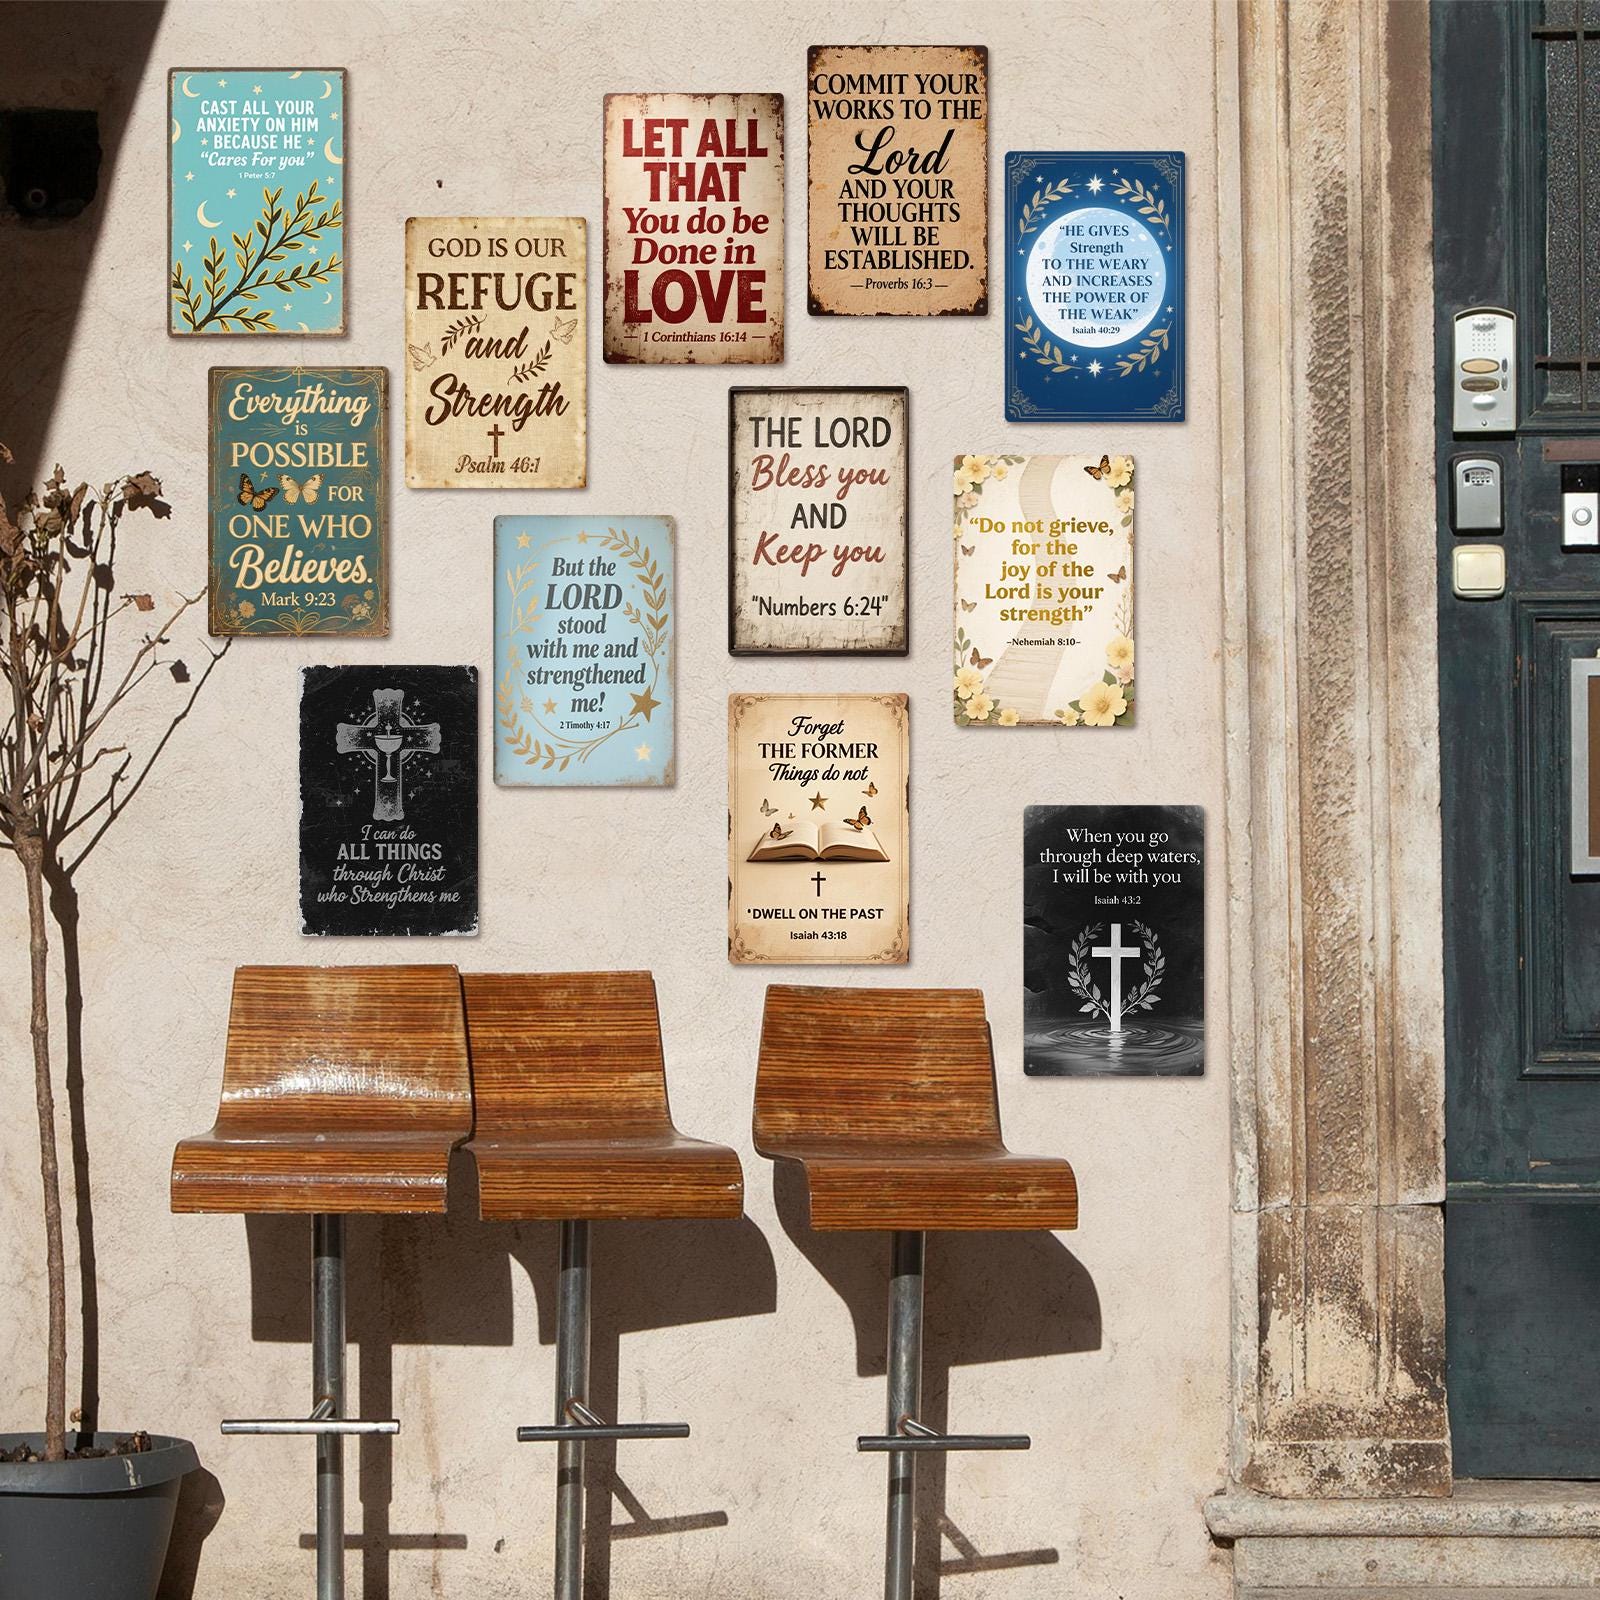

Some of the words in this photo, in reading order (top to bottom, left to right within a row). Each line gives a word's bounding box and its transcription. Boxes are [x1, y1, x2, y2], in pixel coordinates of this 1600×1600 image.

[813, 74, 909, 95] COMMIT
[914, 74, 979, 95] YOUR
[200, 100, 237, 115] CAST
[242, 100, 270, 115] ALL
[274, 100, 314, 115] YOUR
[813, 100, 894, 120] WORKS
[900, 100, 932, 120] TO
[938, 100, 983, 120] THE
[196, 117, 260, 132] ANXIETY
[265, 117, 286, 132] ON
[291, 117, 319, 132] HIM
[214, 135, 278, 149] BECAUSE
[283, 135, 302, 149] HE
[622, 119, 689, 157] LET
[696, 119, 768, 157] ALL
[848, 125, 955, 176] Lord
[200, 152, 248, 167] “Cares
[252, 152, 276, 167] For
[278, 152, 314, 171] you”
[643, 162, 747, 202] THAT
[839, 179, 887, 199] AND
[893, 179, 955, 199] YOUR
[622, 207, 680, 234] You
[687, 206, 725, 234] do
[732, 207, 769, 234] be
[838, 203, 961, 223] THOUGHTS
[850, 226, 907, 246] WILL
[913, 226, 940, 246] BE
[1059, 225, 1084, 237] “HE
[1088, 225, 1129, 237] GIVES
[428, 238, 482, 258] GOD
[487, 238, 508, 258] IS
[515, 238, 567, 258] OUR
[632, 238, 717, 265] Done
[723, 237, 756, 265] in
[1070, 242, 1124, 257] Strength
[824, 250, 974, 270] ESTABLISHED.
[1042, 259, 1062, 270] TO
[1066, 259, 1095, 270] THE
[1099, 259, 1149, 270] WEARY
[1042, 275, 1072, 287] AND
[1076, 275, 1152, 287] INCREASES
[416, 272, 577, 312] REFUGE
[624, 269, 767, 324] LOVE
[1043, 292, 1071, 303] THE
[1075, 292, 1126, 304] POWER
[1130, 292, 1150, 304] OF
[1058, 309, 1087, 320] THE
[1090, 308, 1138, 320] WEAK”
[643, 332, 649, 342] 1
[651, 332, 716, 343] Corinthians
[719, 332, 747, 343] 16:14
[1072, 326, 1096, 334] Isaiah
[1098, 326, 1120, 335] 40:29
[465, 326, 530, 359] and
[228, 382, 371, 428] Everything
[425, 373, 570, 432] Strength
[295, 420, 308, 436] is
[749, 417, 802, 448] THE
[815, 417, 892, 448] LORD
[230, 441, 369, 468] POSSIBLE
[455, 454, 506, 474] Psalm
[510, 457, 540, 474] 46:1
[751, 453, 831, 492] Bless
[838, 466, 890, 501] you
[328, 486, 364, 502] FOR
[790, 503, 847, 529] AND
[228, 515, 290, 539] ONE
[297, 515, 373, 539] WHO
[970, 517, 1005, 534] “Do
[1011, 520, 1044, 534] not
[1049, 517, 1114, 538] grieve,
[752, 530, 827, 578] Keep
[831, 544, 886, 578] you
[1011, 539, 1040, 555] for
[1046, 540, 1078, 556] the
[229, 543, 373, 590] Believes.
[551, 557, 585, 577] But
[589, 556, 616, 577] the
[1000, 561, 1030, 582] joy
[1036, 561, 1058, 577] of
[1062, 561, 1094, 577] the
[261, 592, 300, 607] Mark
[305, 592, 336, 607] 9:23
[544, 583, 623, 610] LORD
[985, 583, 1030, 599] Lord
[1037, 583, 1052, 599] is
[1057, 586, 1104, 604] your
[558, 613, 607, 634] stood
[1000, 605, 1093, 626] strength”
[526, 638, 568, 659] with
[572, 643, 600, 659] me
[603, 637, 639, 659] and
[527, 662, 647, 692] strengthened
[571, 691, 606, 713] me!
[560, 721, 564, 729] 2
[565, 721, 595, 731] Timothy
[596, 721, 610, 729] 4:17
[788, 716, 845, 741] Forget
[758, 743, 796, 759] THE
[801, 743, 879, 759] FORMER
[769, 763, 820, 788] Things
[822, 765, 840, 781] do
[842, 766, 869, 781] not
[361, 825, 372, 841] I
[373, 829, 398, 841] can
[399, 825, 416, 841] do
[1066, 828, 1113, 843] When
[1116, 832, 1146, 847] you
[1150, 832, 1169, 848] go
[337, 844, 370, 860] ALL
[375, 843, 442, 860] THINGS
[1039, 848, 1102, 868] through
[1106, 848, 1143, 868] deep
[1147, 851, 1201, 865] waters,
[333, 863, 394, 889] through
[397, 863, 447, 882] Christ
[1052, 870, 1059, 884] I
[1063, 868, 1089, 884] will
[1094, 868, 1112, 884] be
[1116, 868, 1148, 884] with
[1152, 873, 1182, 887] you
[317, 885, 348, 903] who
[350, 885, 437, 910] Strengthens
[440, 890, 460, 903] me
[1094, 896, 1120, 905] Isaiah
[1122, 896, 1141, 905] 43:2
[799, 908, 819, 920] ON
[821, 908, 847, 920] THE
[850, 908, 884, 920] PAST
[790, 931, 819, 940] Isaiah
[821, 931, 847, 940] 43:18
